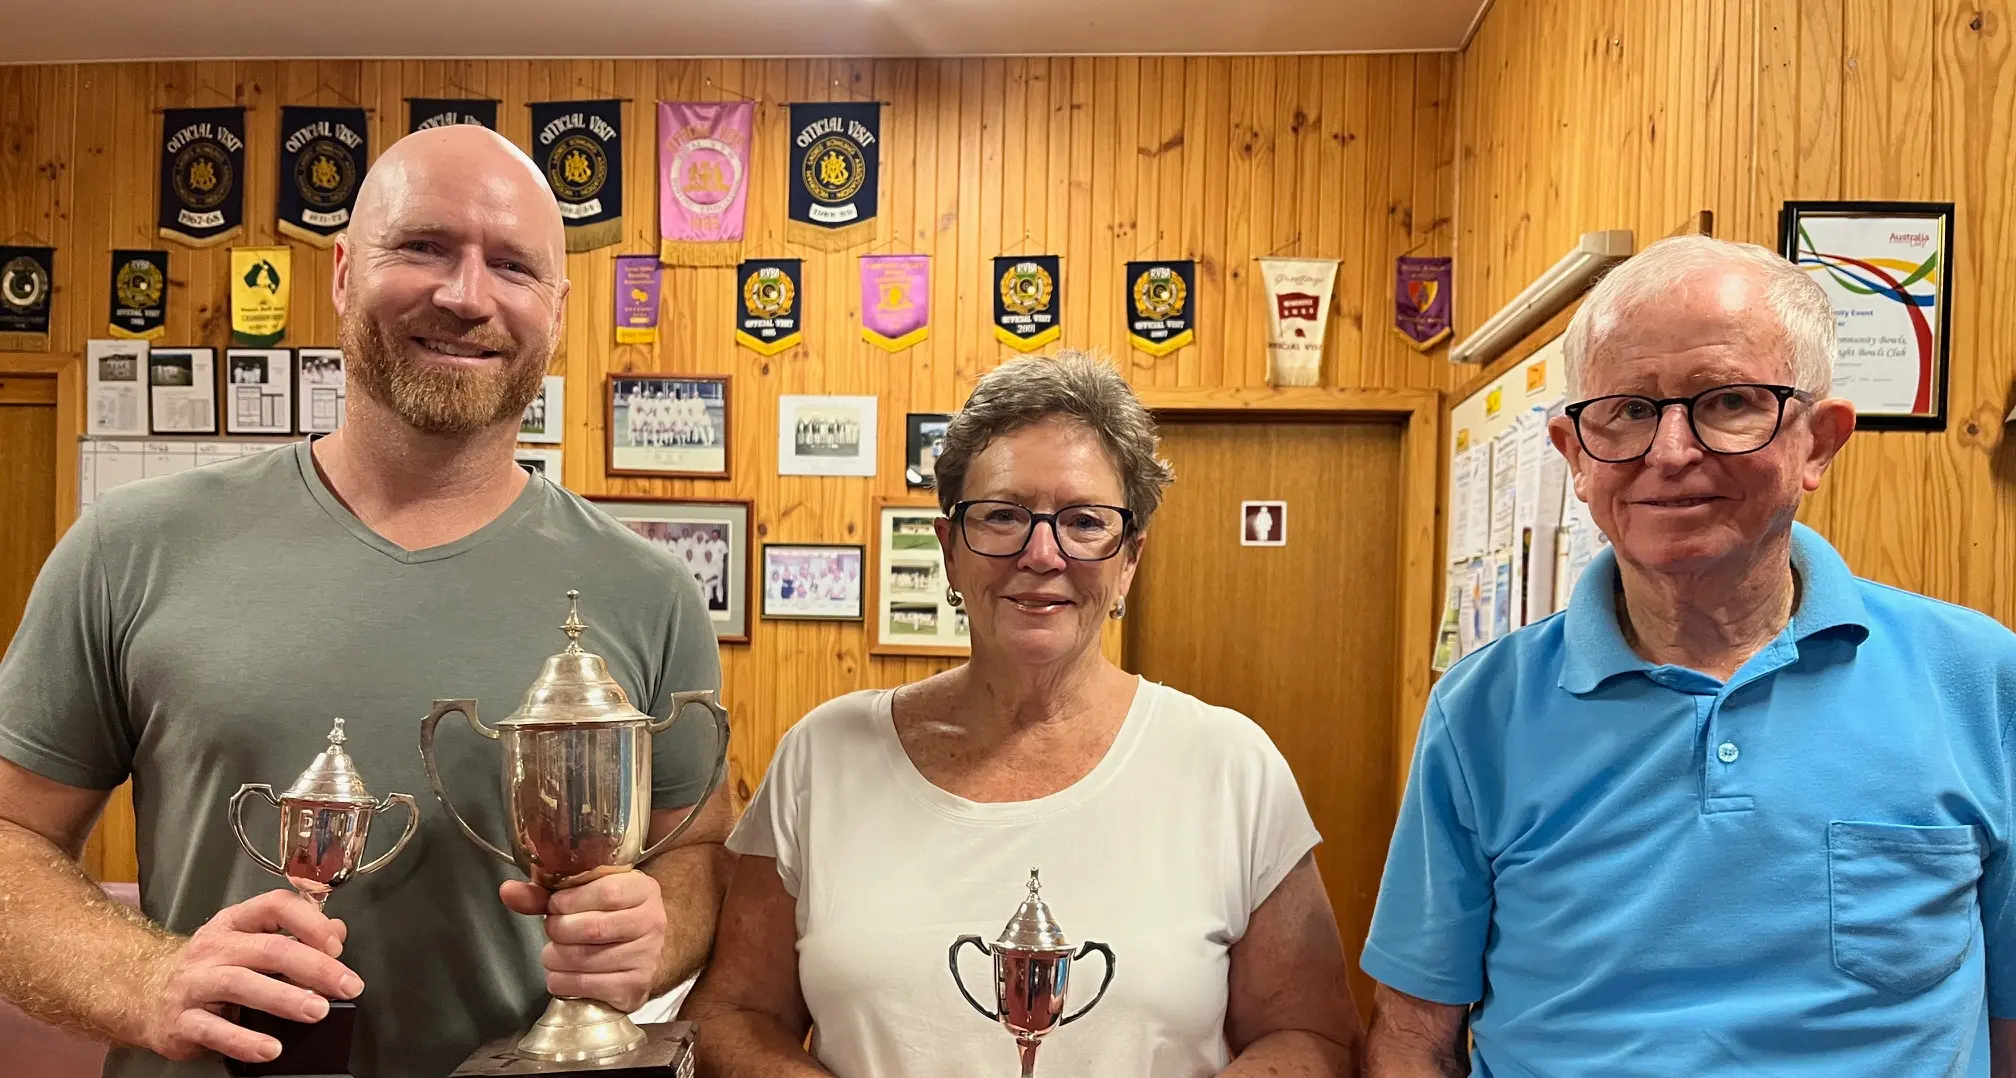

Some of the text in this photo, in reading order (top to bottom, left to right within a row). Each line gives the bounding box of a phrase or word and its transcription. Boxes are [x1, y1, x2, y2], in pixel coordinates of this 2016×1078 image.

[540, 112, 617, 145] OFFICIAL VISIT
[797, 117, 876, 147] OFFICIAL VISIT
[167, 122, 243, 153] OFFICIAL VISIT
[284, 121, 363, 153] OFFICIAL VISIT
[1890, 232, 1930, 241] Australia
[1150, 267, 1171, 279] RVBA
[744, 318, 775, 328] OFFICIAL
[1002, 315, 1033, 324] OFFICIAL
[1134, 321, 1166, 330] OFFICIAL
[1886, 346, 1907, 358] Club
